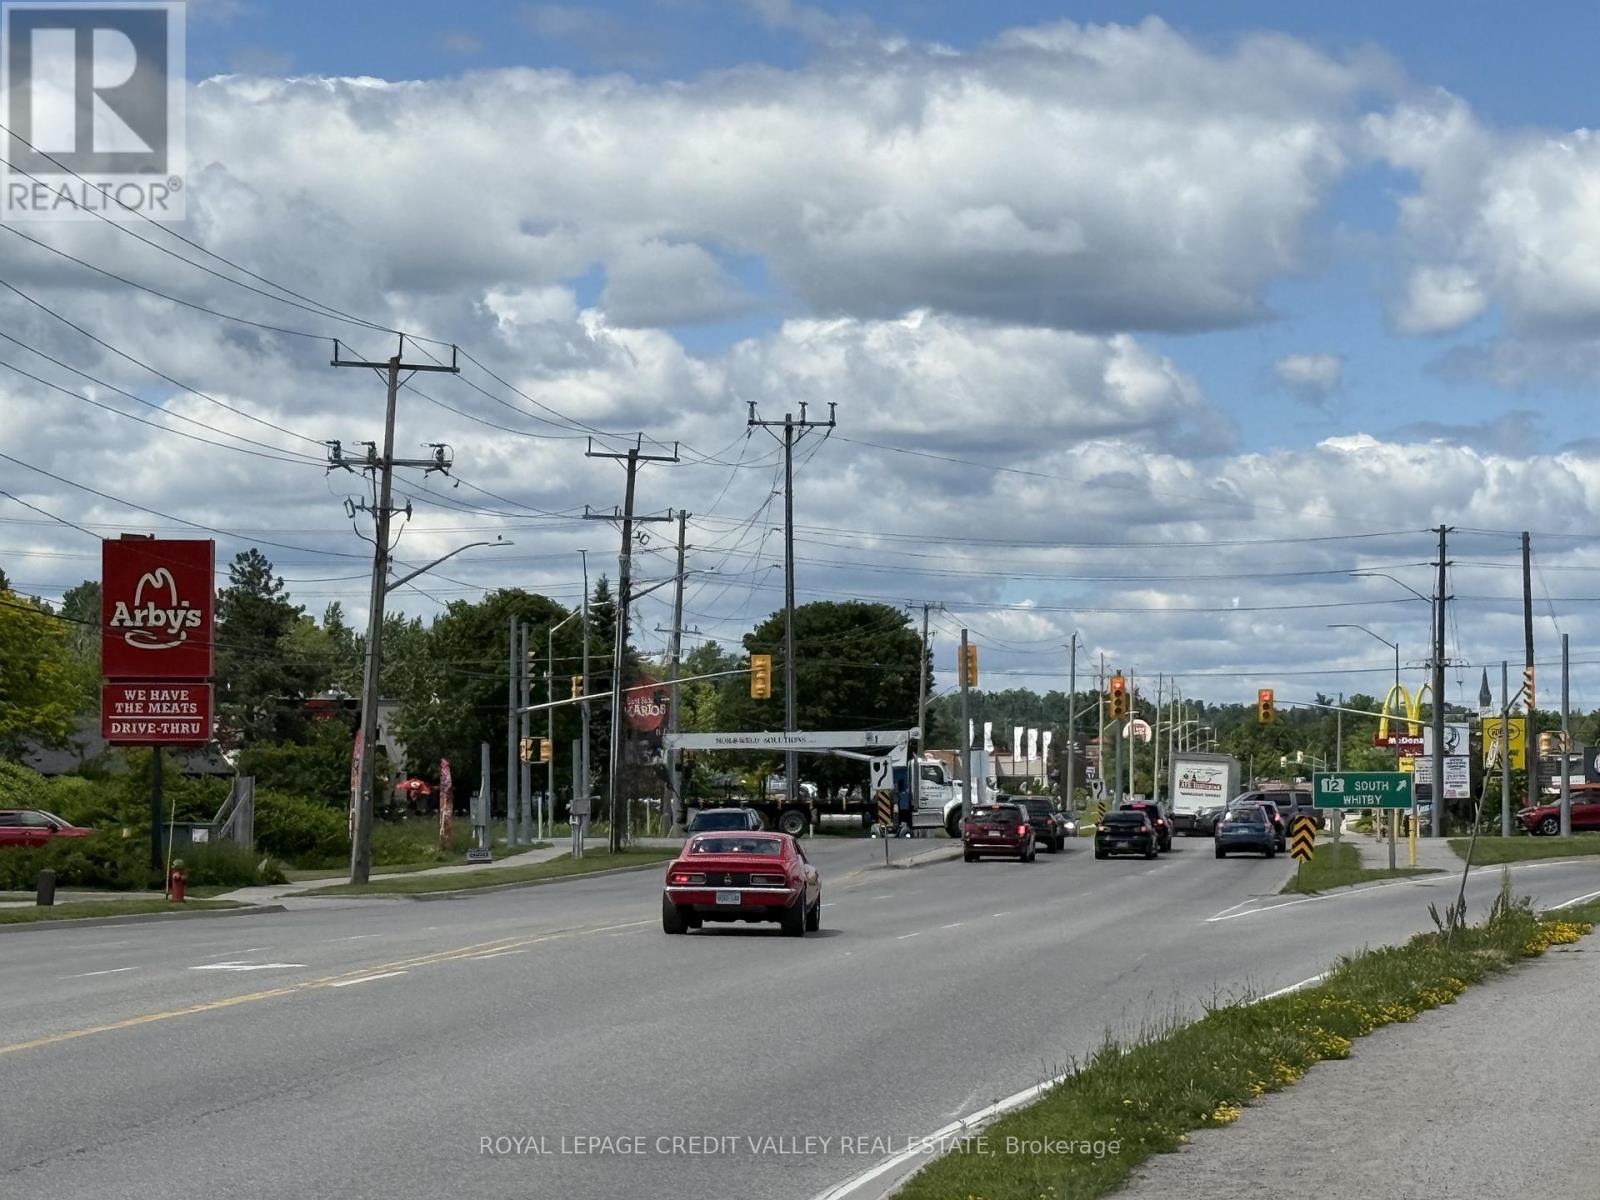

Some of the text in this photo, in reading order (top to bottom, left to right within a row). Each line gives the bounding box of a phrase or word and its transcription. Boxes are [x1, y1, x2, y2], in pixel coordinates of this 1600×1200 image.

[110, 601, 202, 634] Arby's
[124, 690, 189, 700] WE HAVE
[115, 703, 197, 713] THE MEATS
[111, 723, 201, 734] DRIVE-THRU
[1326, 780, 1389, 791] 12 SOUTH
[1343, 795, 1382, 805] WHITBY
